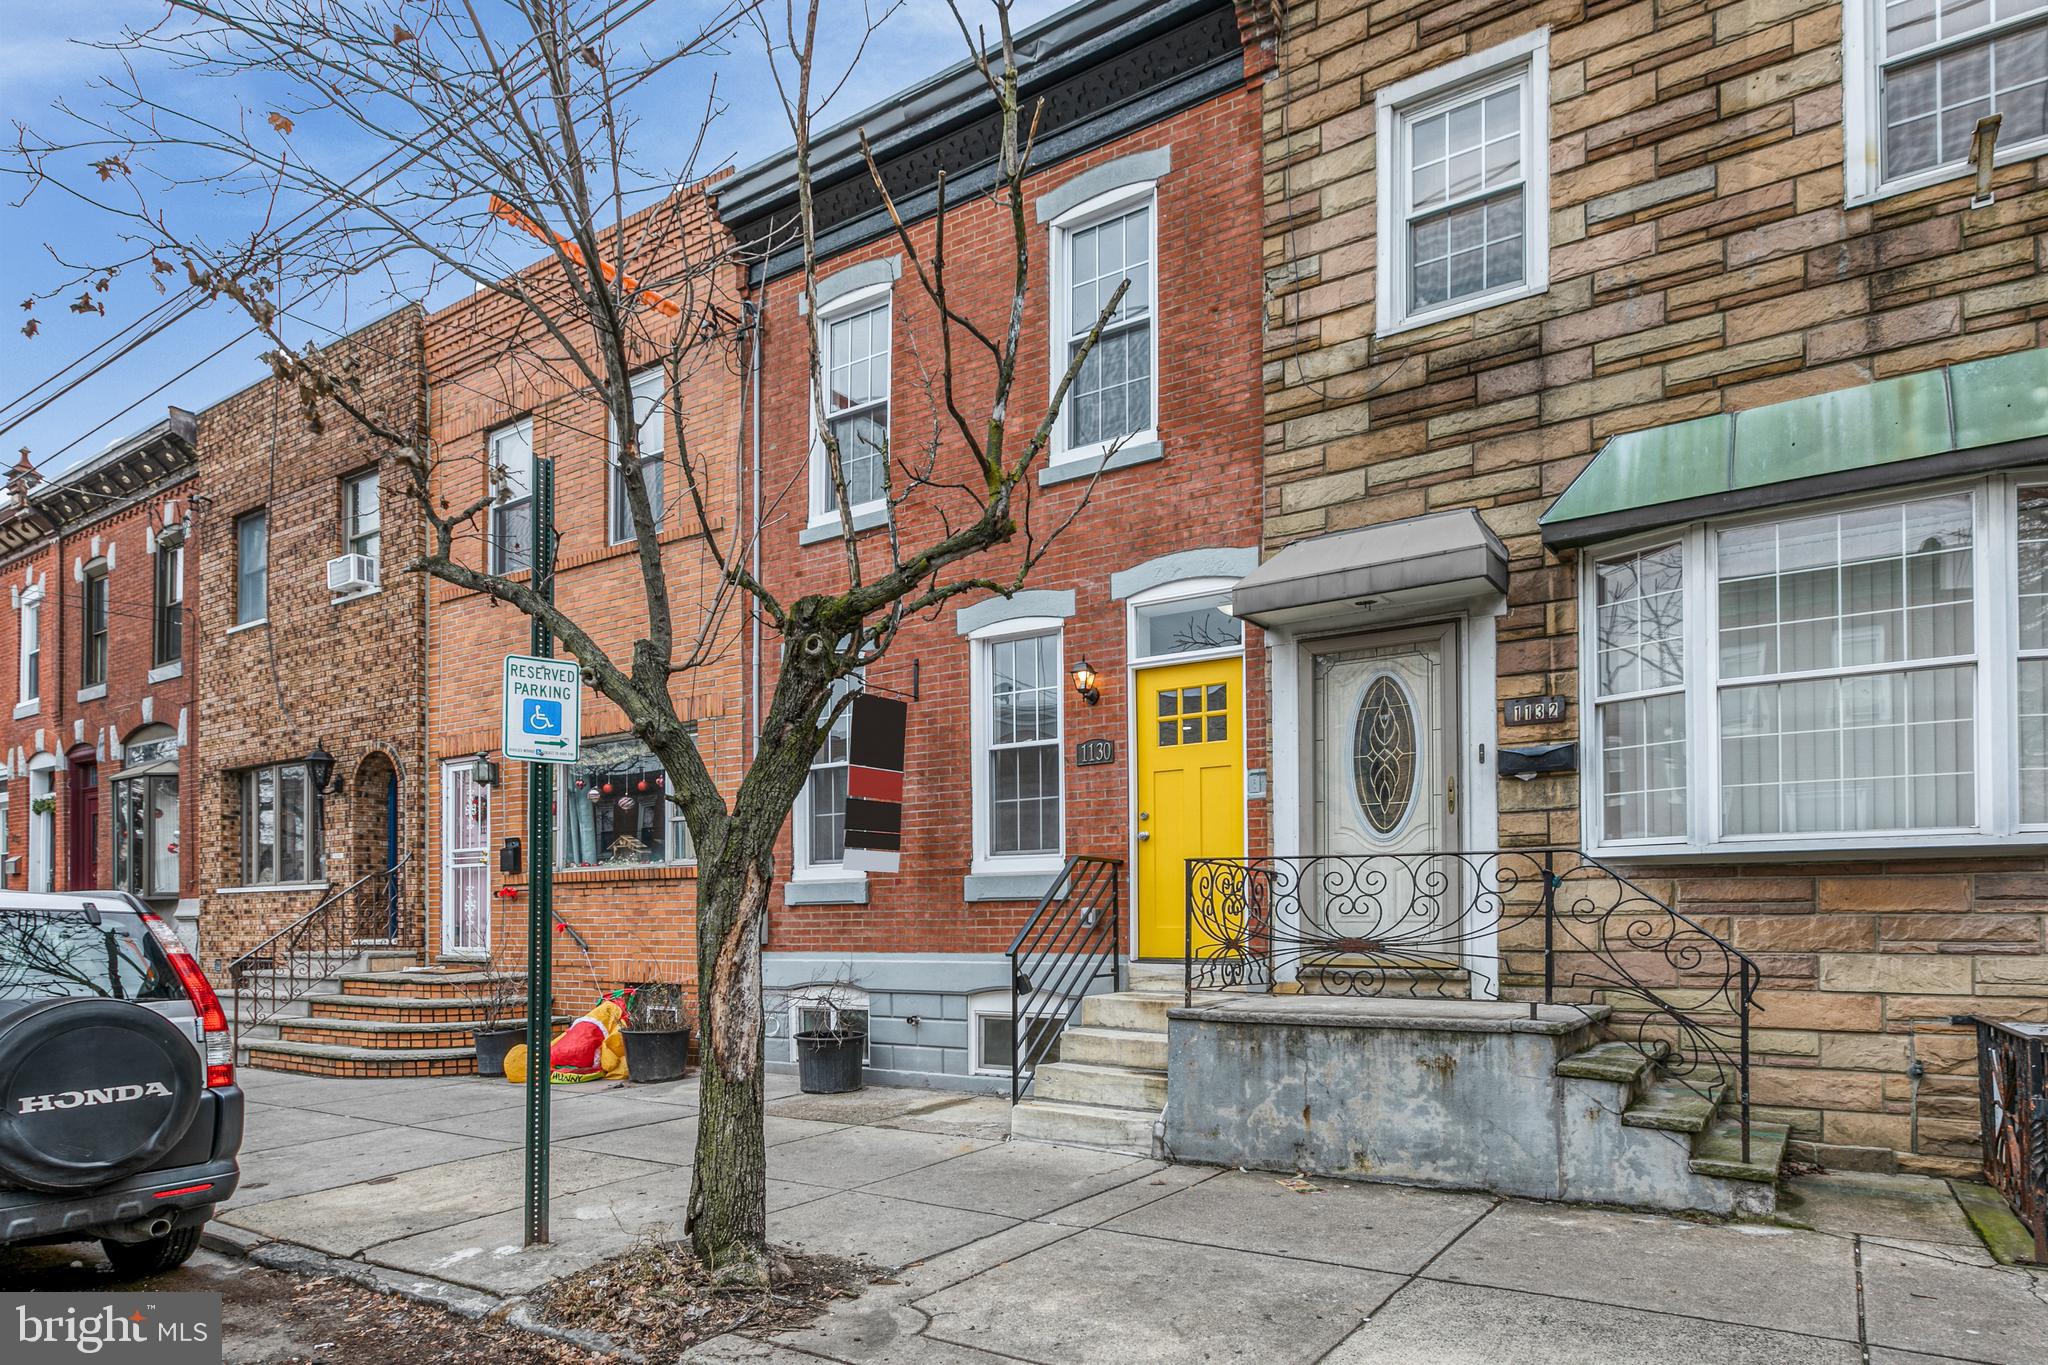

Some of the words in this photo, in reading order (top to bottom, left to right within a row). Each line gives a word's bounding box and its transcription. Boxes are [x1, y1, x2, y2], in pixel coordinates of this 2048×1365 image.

[510, 663, 575, 683] RESERVED
[514, 682, 571, 700] PARKING
[1514, 702, 1558, 721] 1132
[1081, 742, 1111, 762] 1130
[552, 1072, 583, 1082] HUNNY
[18, 1081, 173, 1114] HONDA
